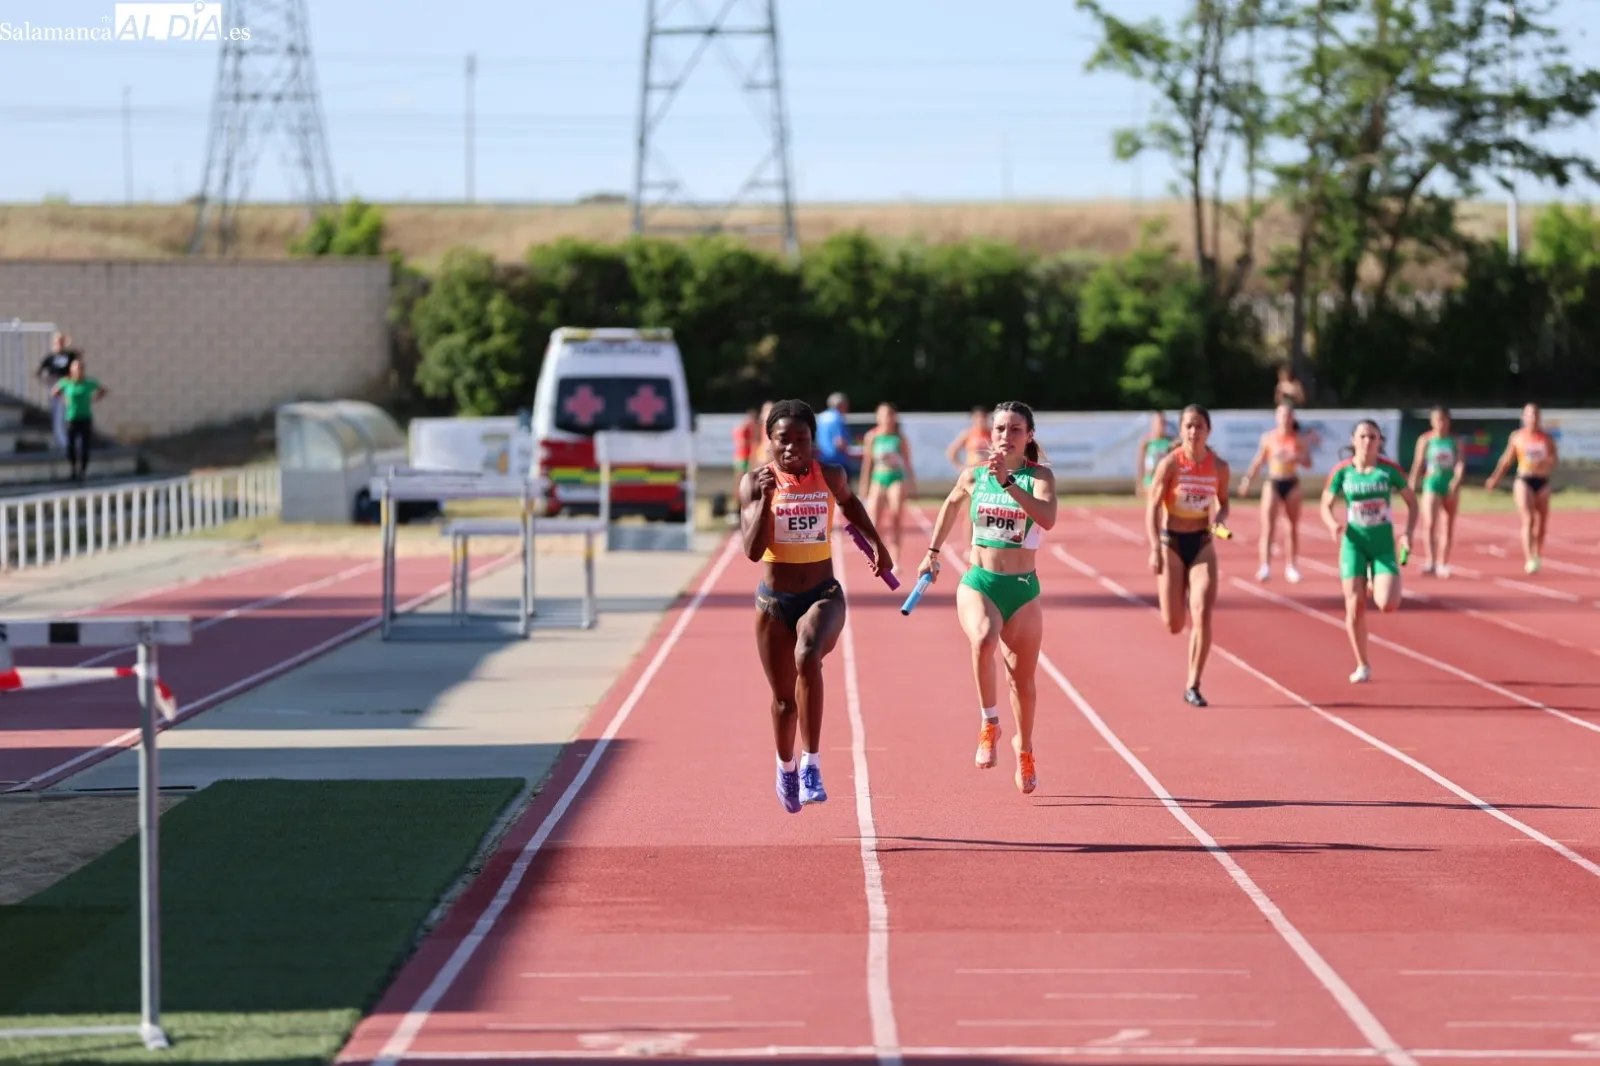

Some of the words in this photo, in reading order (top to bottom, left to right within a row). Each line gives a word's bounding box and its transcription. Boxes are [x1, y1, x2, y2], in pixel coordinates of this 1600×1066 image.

[775, 504, 828, 517] bedunia
[977, 505, 1026, 520] bedunia
[788, 516, 818, 531] ESP
[986, 515, 1015, 531] POR
